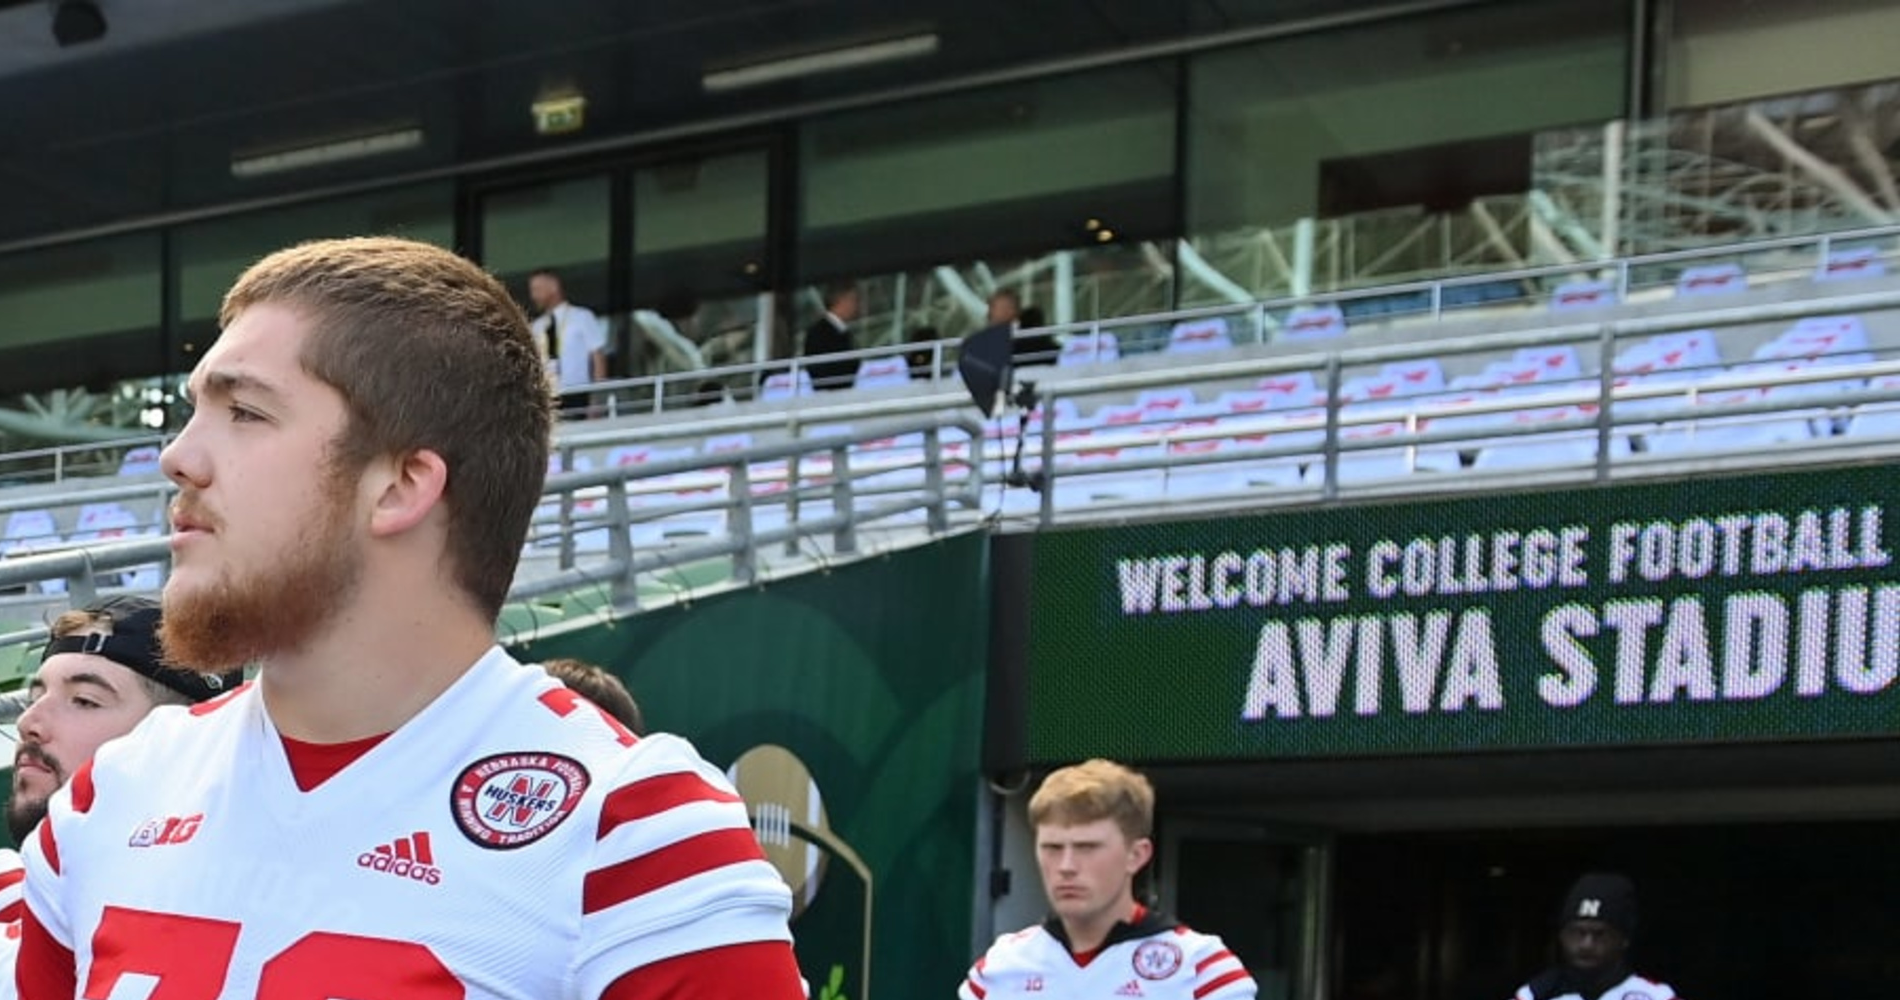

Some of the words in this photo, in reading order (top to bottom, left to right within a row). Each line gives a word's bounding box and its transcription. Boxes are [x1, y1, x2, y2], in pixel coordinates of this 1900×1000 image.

[1117, 542, 1351, 615] WELCOME
[1366, 525, 1590, 599] COLLEGE
[1608, 503, 1892, 585] FOOTBALL
[1242, 606, 1505, 721] AVIVA
[485, 785, 557, 812] HUSKERS
[357, 852, 442, 886] adidas
[1579, 899, 1601, 917] N
